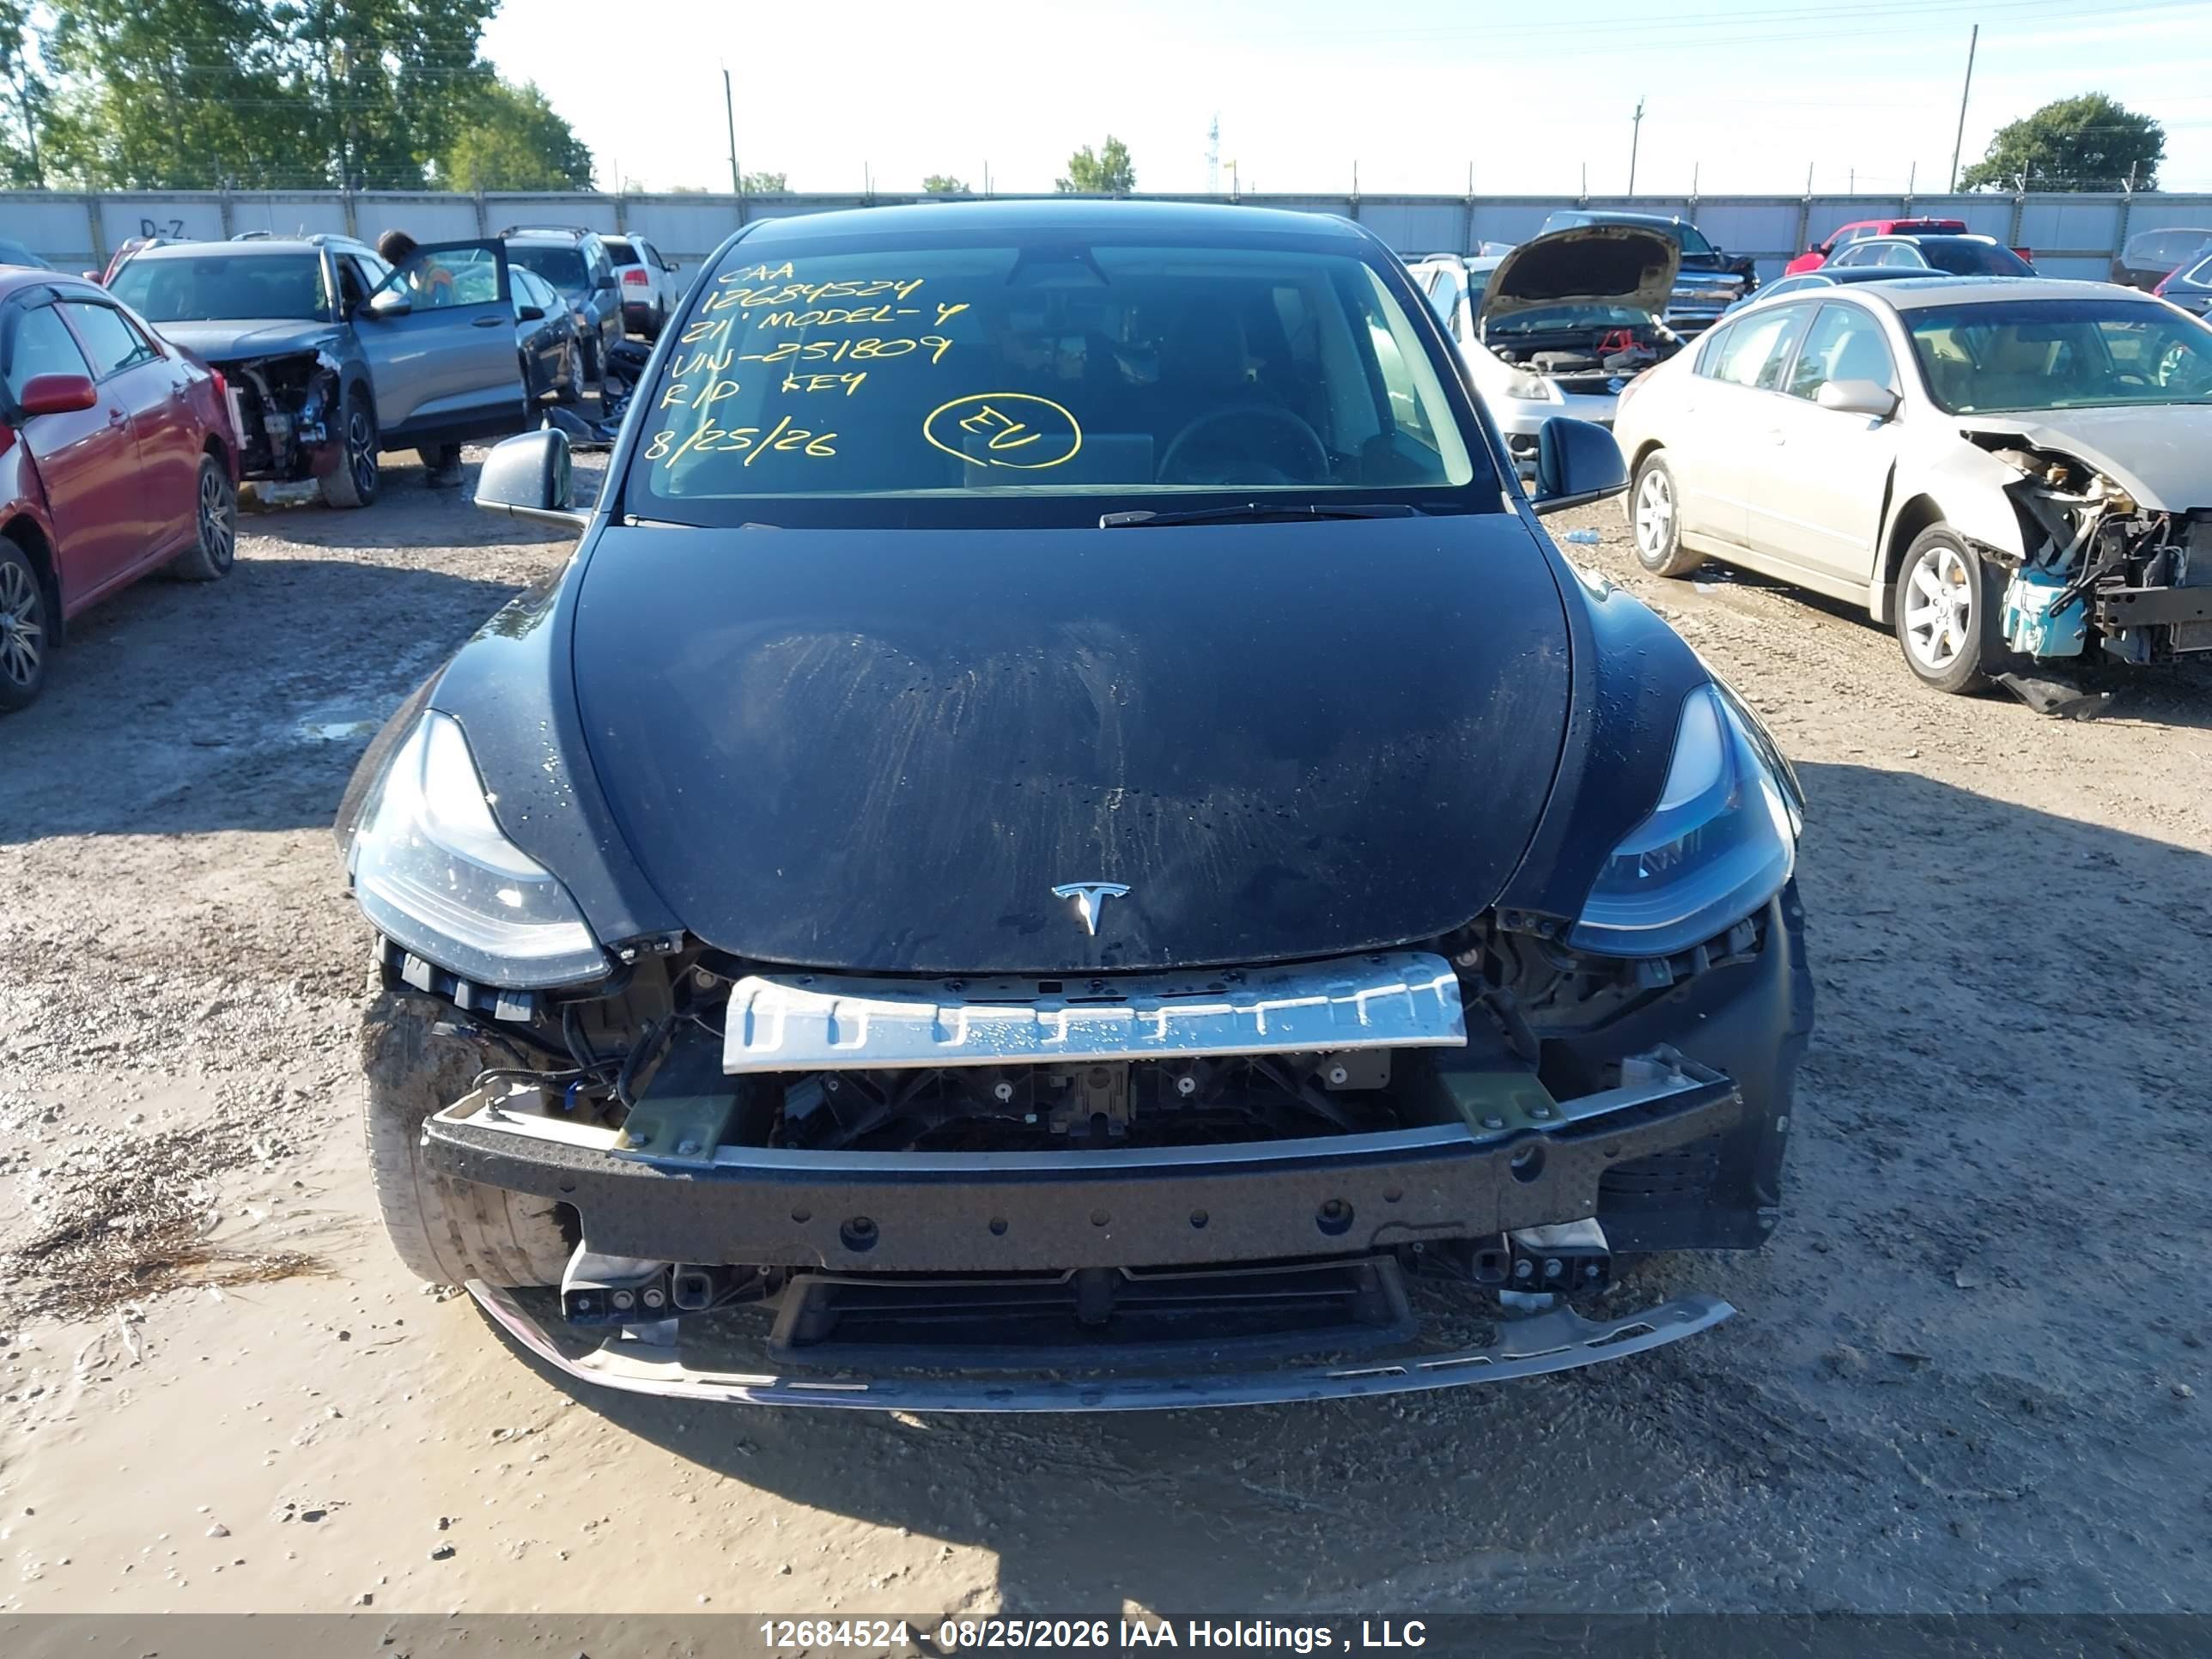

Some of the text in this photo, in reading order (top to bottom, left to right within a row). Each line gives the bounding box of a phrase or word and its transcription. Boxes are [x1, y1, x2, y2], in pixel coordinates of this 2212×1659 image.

[718, 261, 794, 283] CAA
[702, 277, 925, 314] 12684524
[781, 370, 868, 397] KEY
[643, 415, 838, 469] 8/25/26
